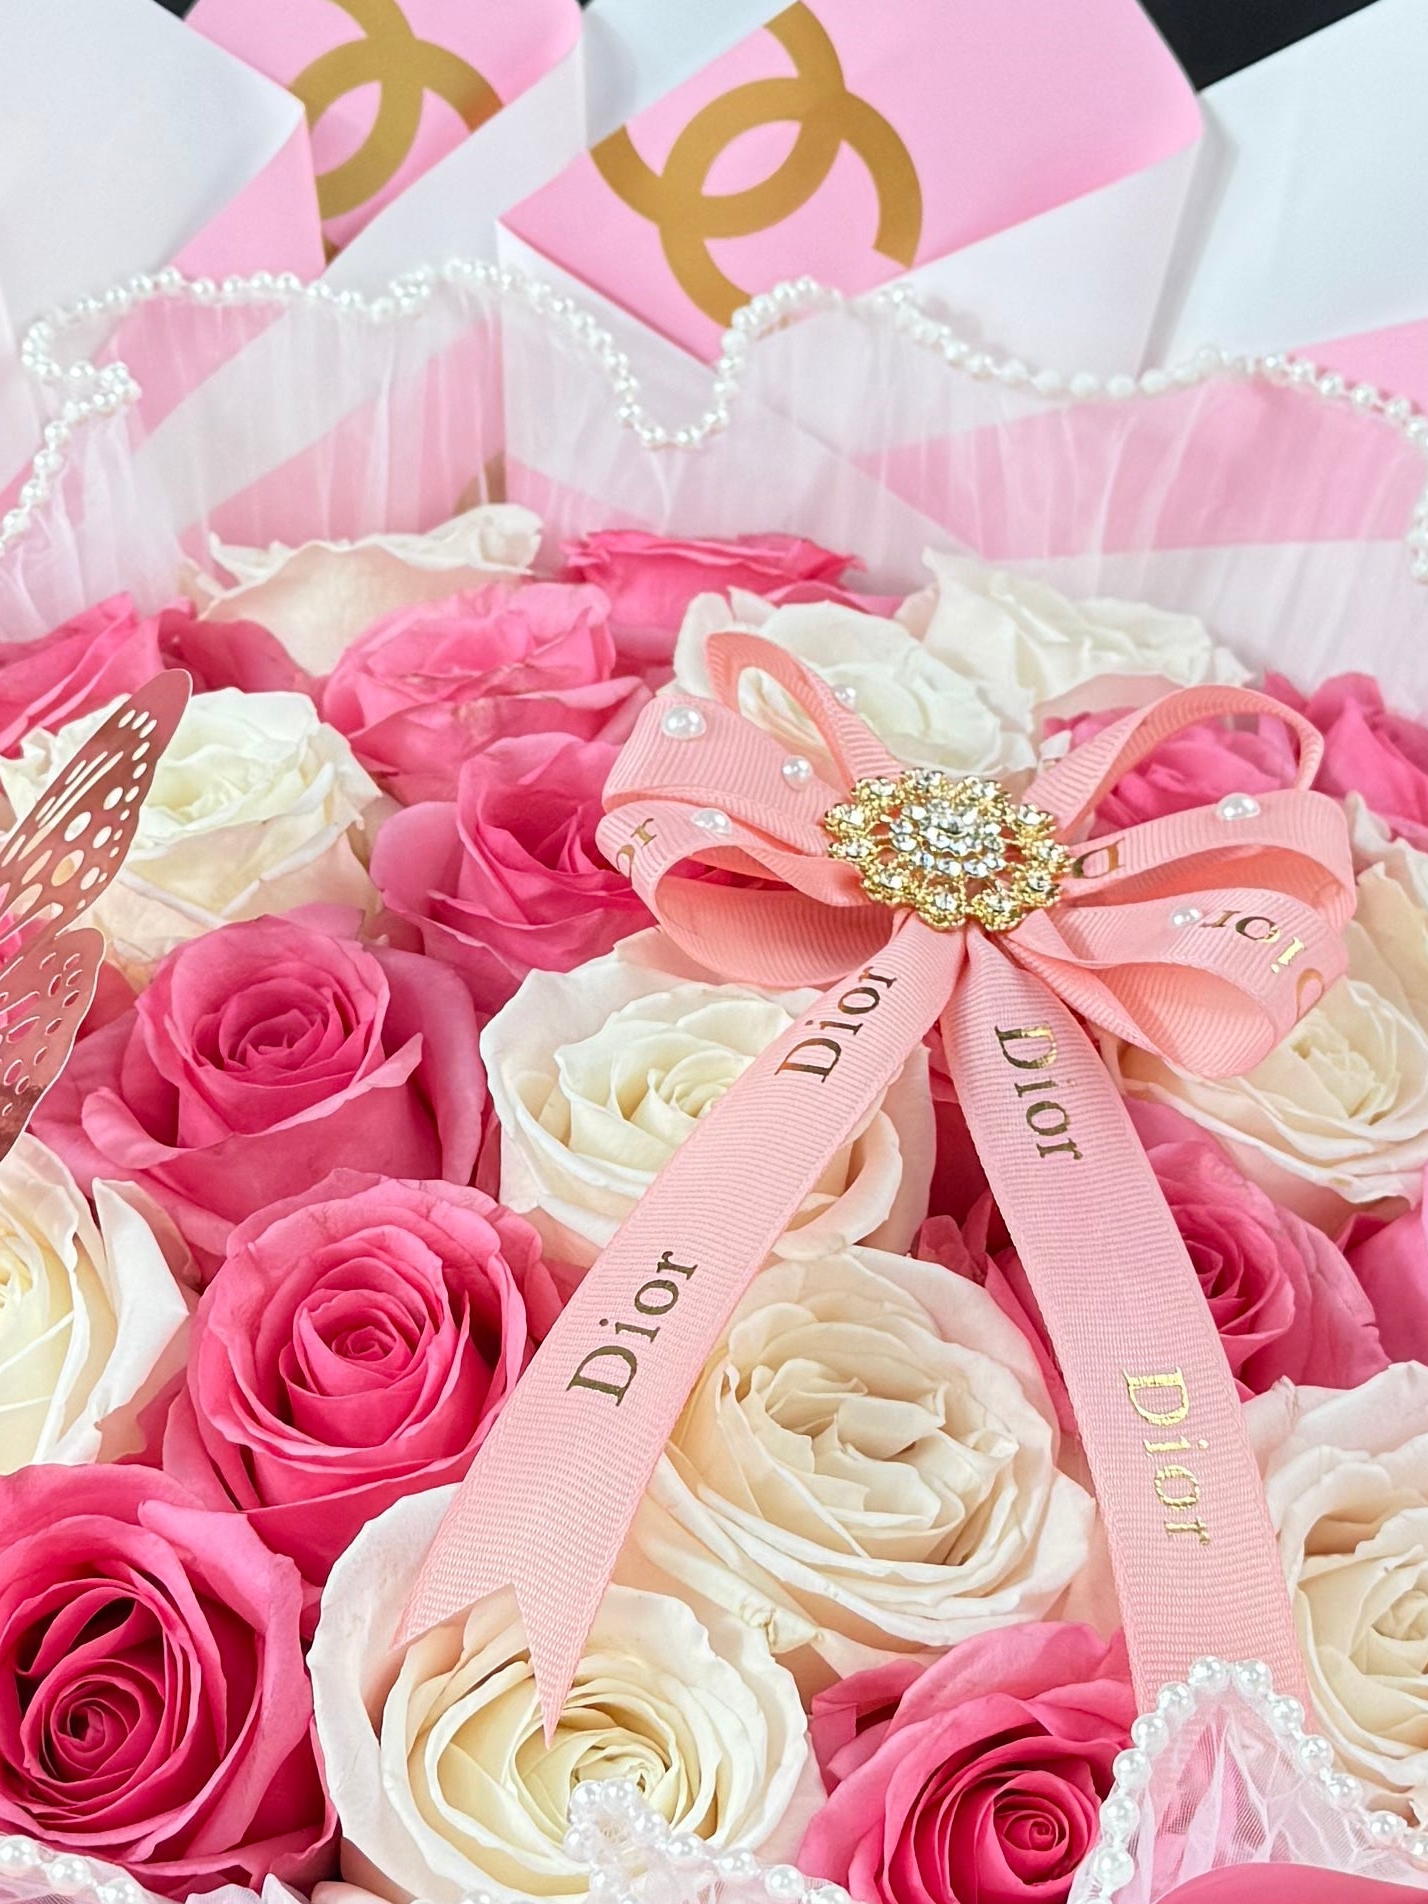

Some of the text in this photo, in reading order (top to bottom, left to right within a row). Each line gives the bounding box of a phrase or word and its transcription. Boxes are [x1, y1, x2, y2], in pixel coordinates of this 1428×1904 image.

[775, 965, 898, 1082] Dior
[995, 1024, 1082, 1161] Dior
[566, 1250, 699, 1406] Dior
[1124, 1366, 1210, 1546] Dior
